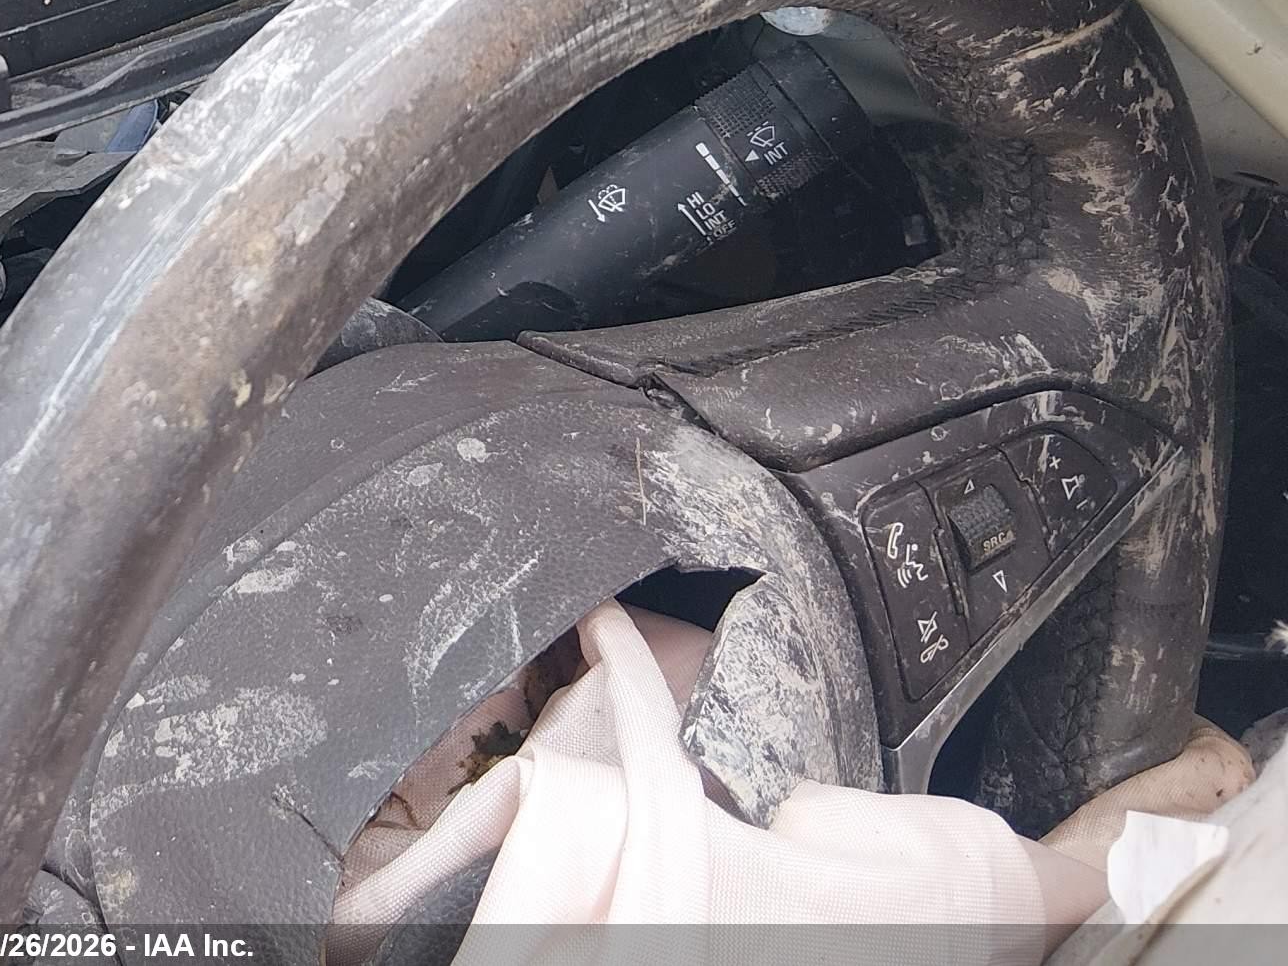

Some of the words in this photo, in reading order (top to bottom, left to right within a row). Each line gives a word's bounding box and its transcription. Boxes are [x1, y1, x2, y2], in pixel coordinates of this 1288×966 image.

[763, 141, 790, 166] INT
[686, 191, 706, 210] HI
[695, 202, 717, 221] LO
[703, 209, 728, 231] INT
[982, 531, 1007, 553] SRC
